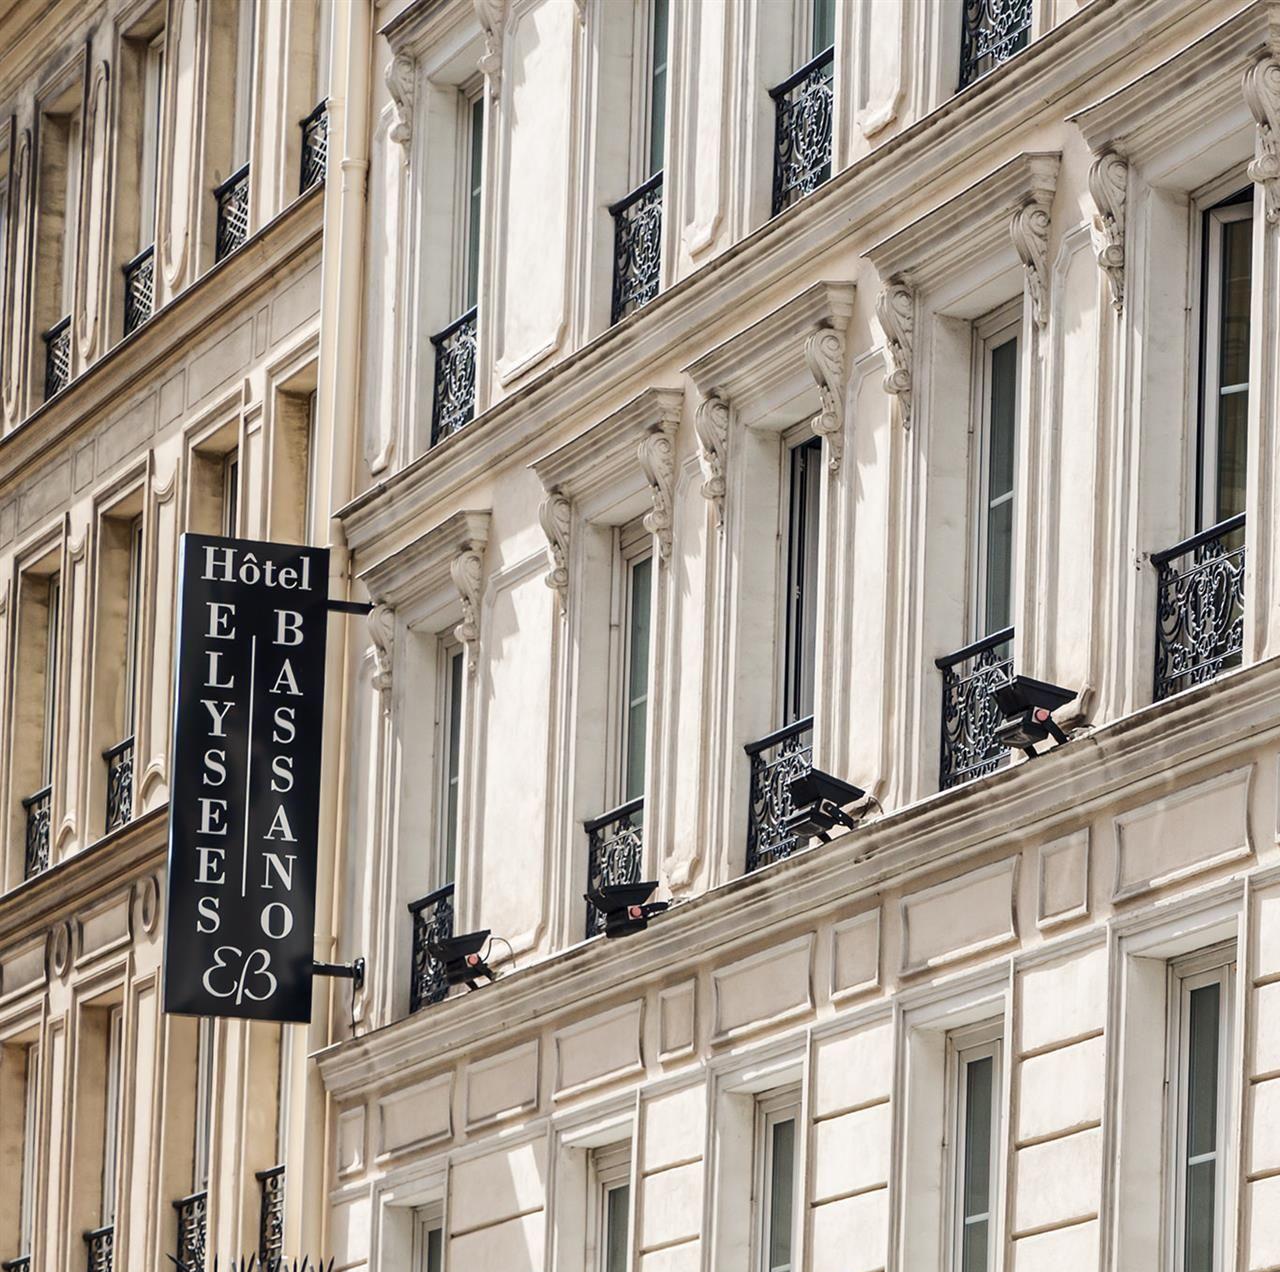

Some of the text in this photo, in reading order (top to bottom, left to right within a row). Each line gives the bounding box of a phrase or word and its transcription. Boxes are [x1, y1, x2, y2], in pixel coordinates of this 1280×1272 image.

[201, 546, 312, 591] Hôtel
[194, 602, 236, 934] ELYSEES
[261, 609, 304, 940] BASSANO
